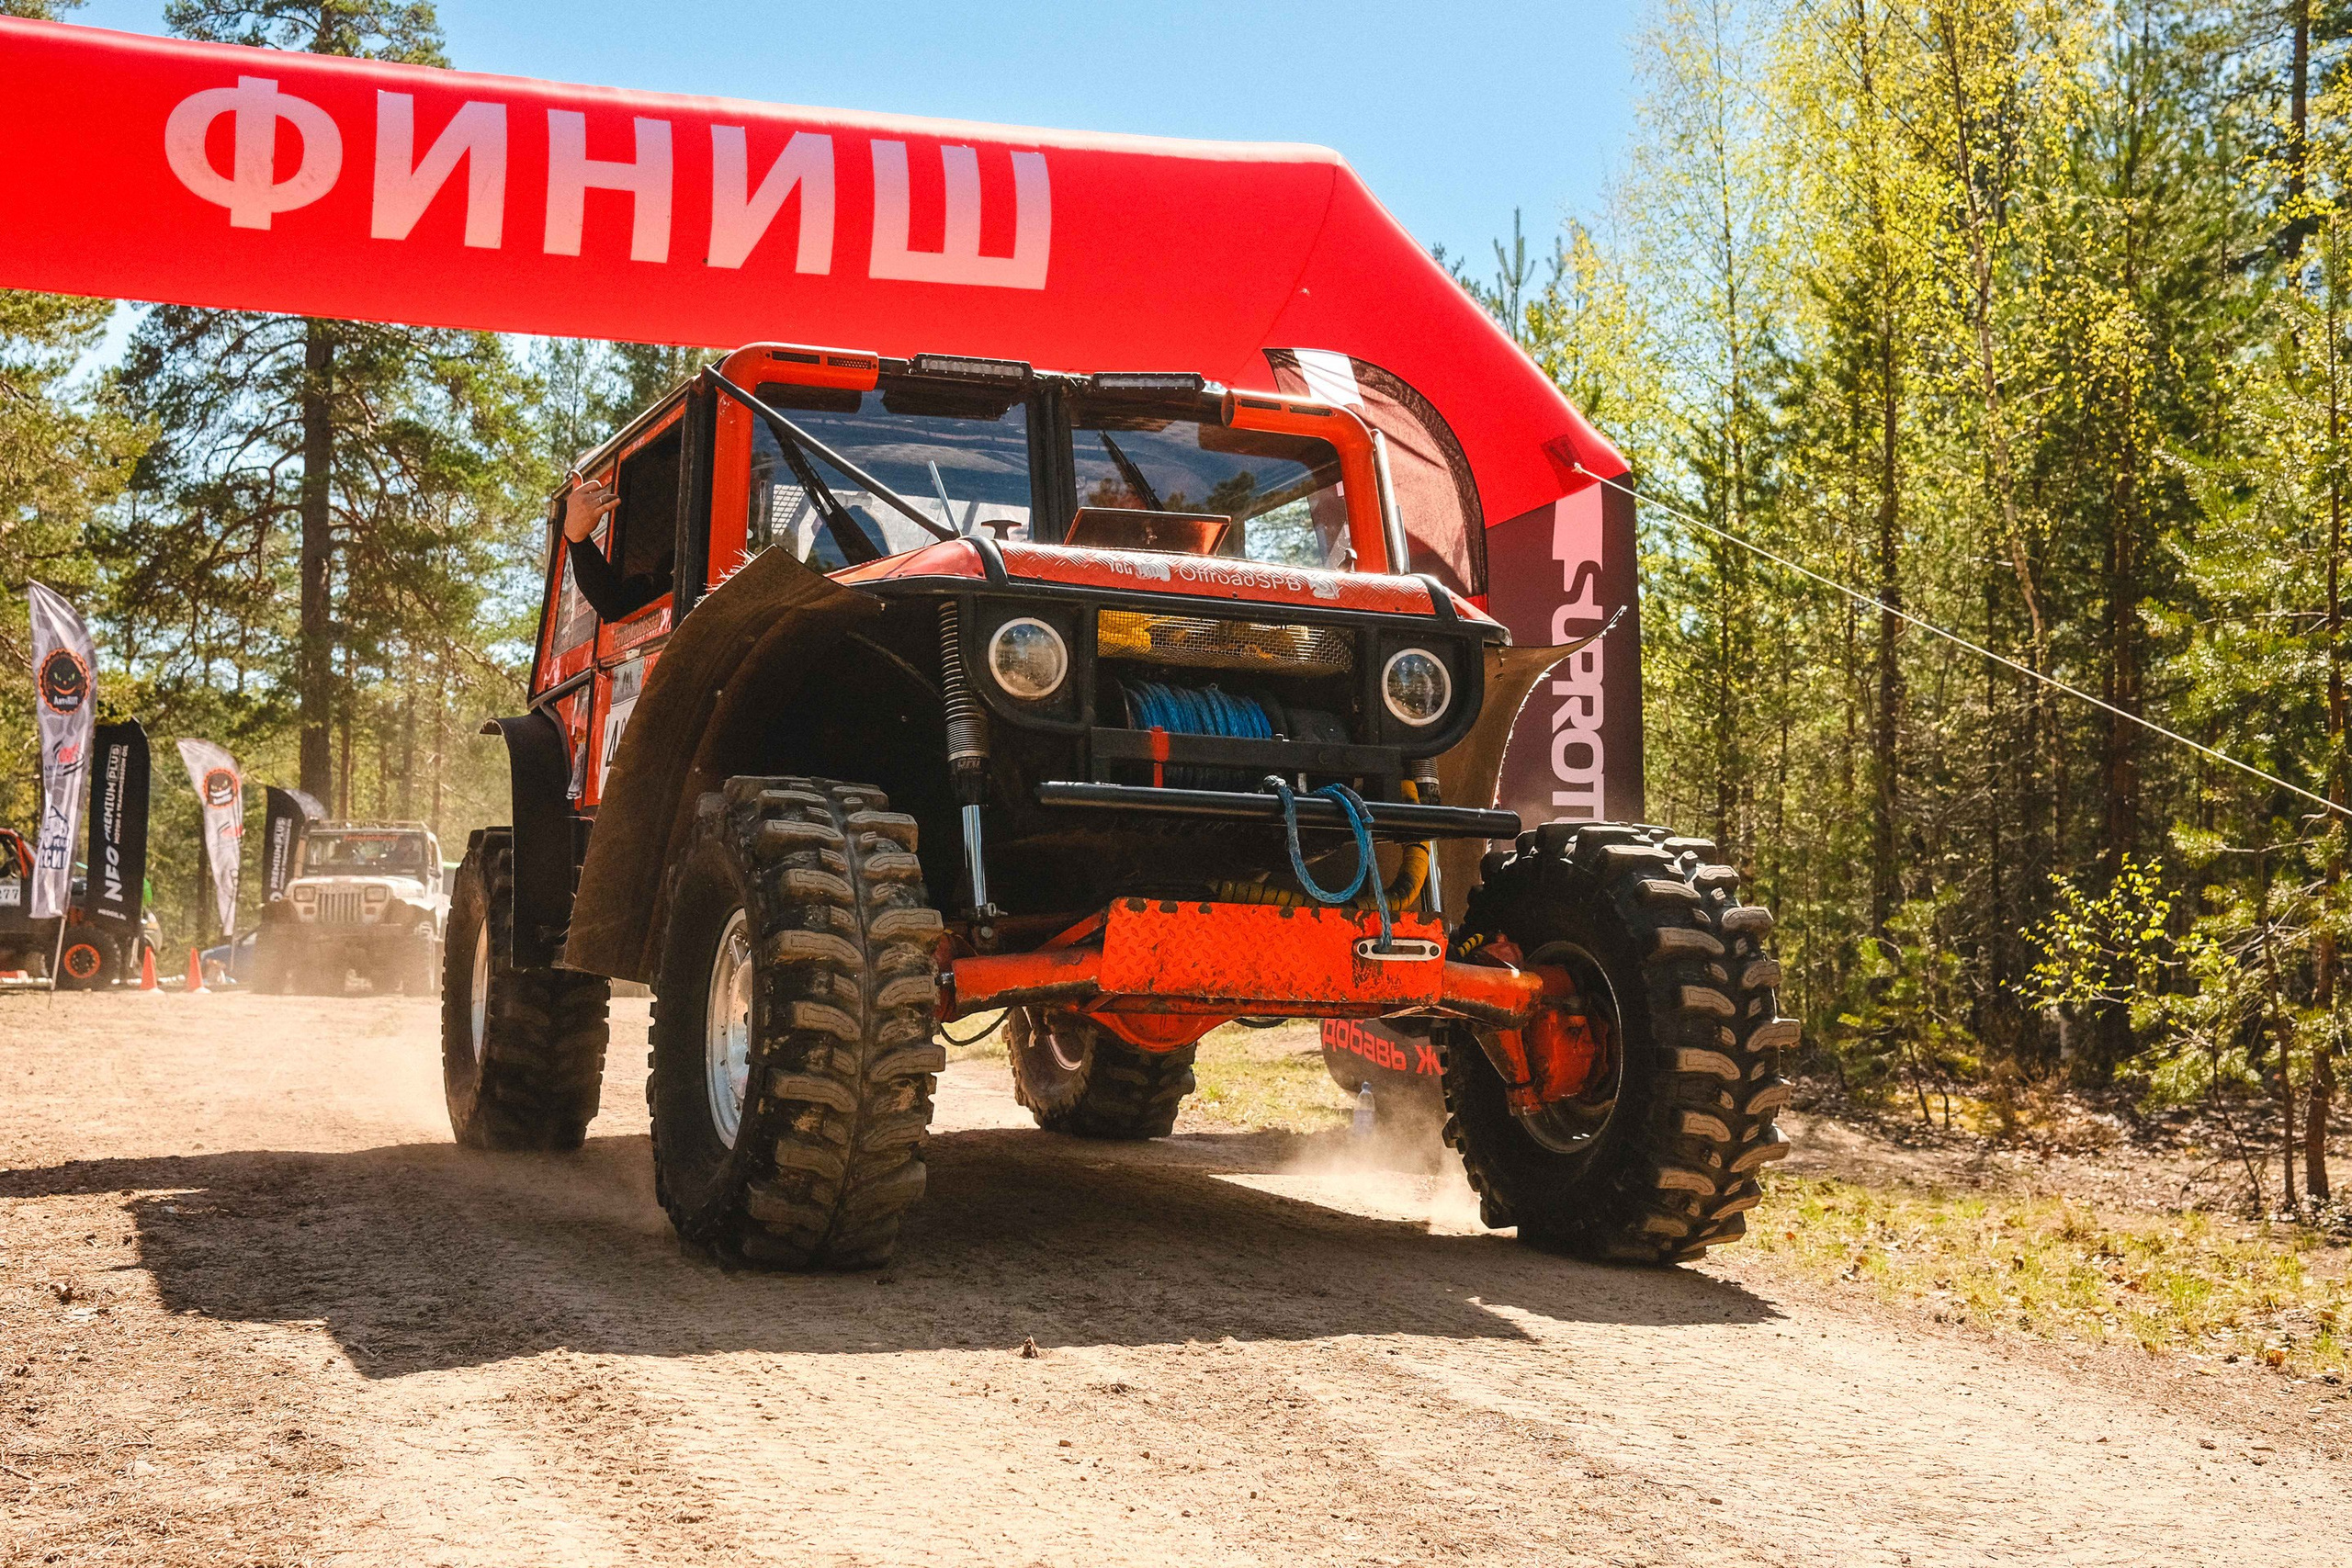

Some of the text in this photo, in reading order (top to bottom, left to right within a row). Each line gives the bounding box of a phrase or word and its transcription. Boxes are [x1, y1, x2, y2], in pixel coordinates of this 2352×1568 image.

[164, 75, 1053, 290] ФИНИШ
[1551, 559, 1605, 824] SUPROT
[108, 747, 120, 779] PLUS
[104, 845, 123, 902] NEO
